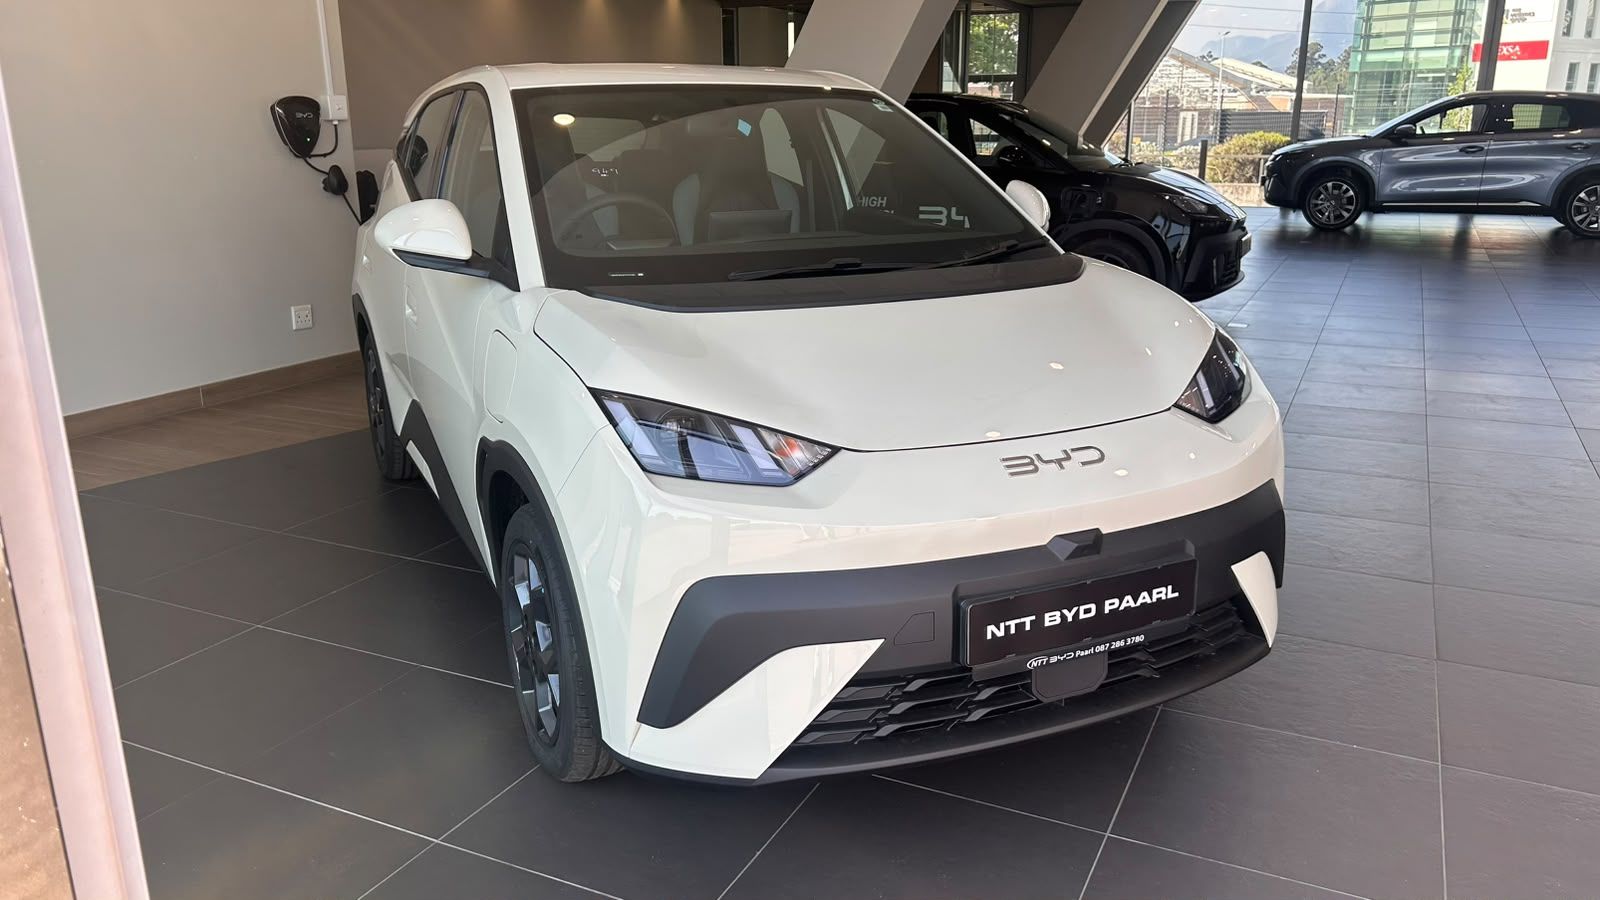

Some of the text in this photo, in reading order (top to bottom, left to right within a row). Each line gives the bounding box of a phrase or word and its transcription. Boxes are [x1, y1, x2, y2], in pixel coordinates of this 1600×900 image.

[857, 196, 887, 208] HIGH
[1000, 445, 1105, 477] BYD
[986, 585, 1179, 640] NTT BYD PAARL
[1029, 634, 1145, 668] NTT BYD Paarl 087 286 3780
